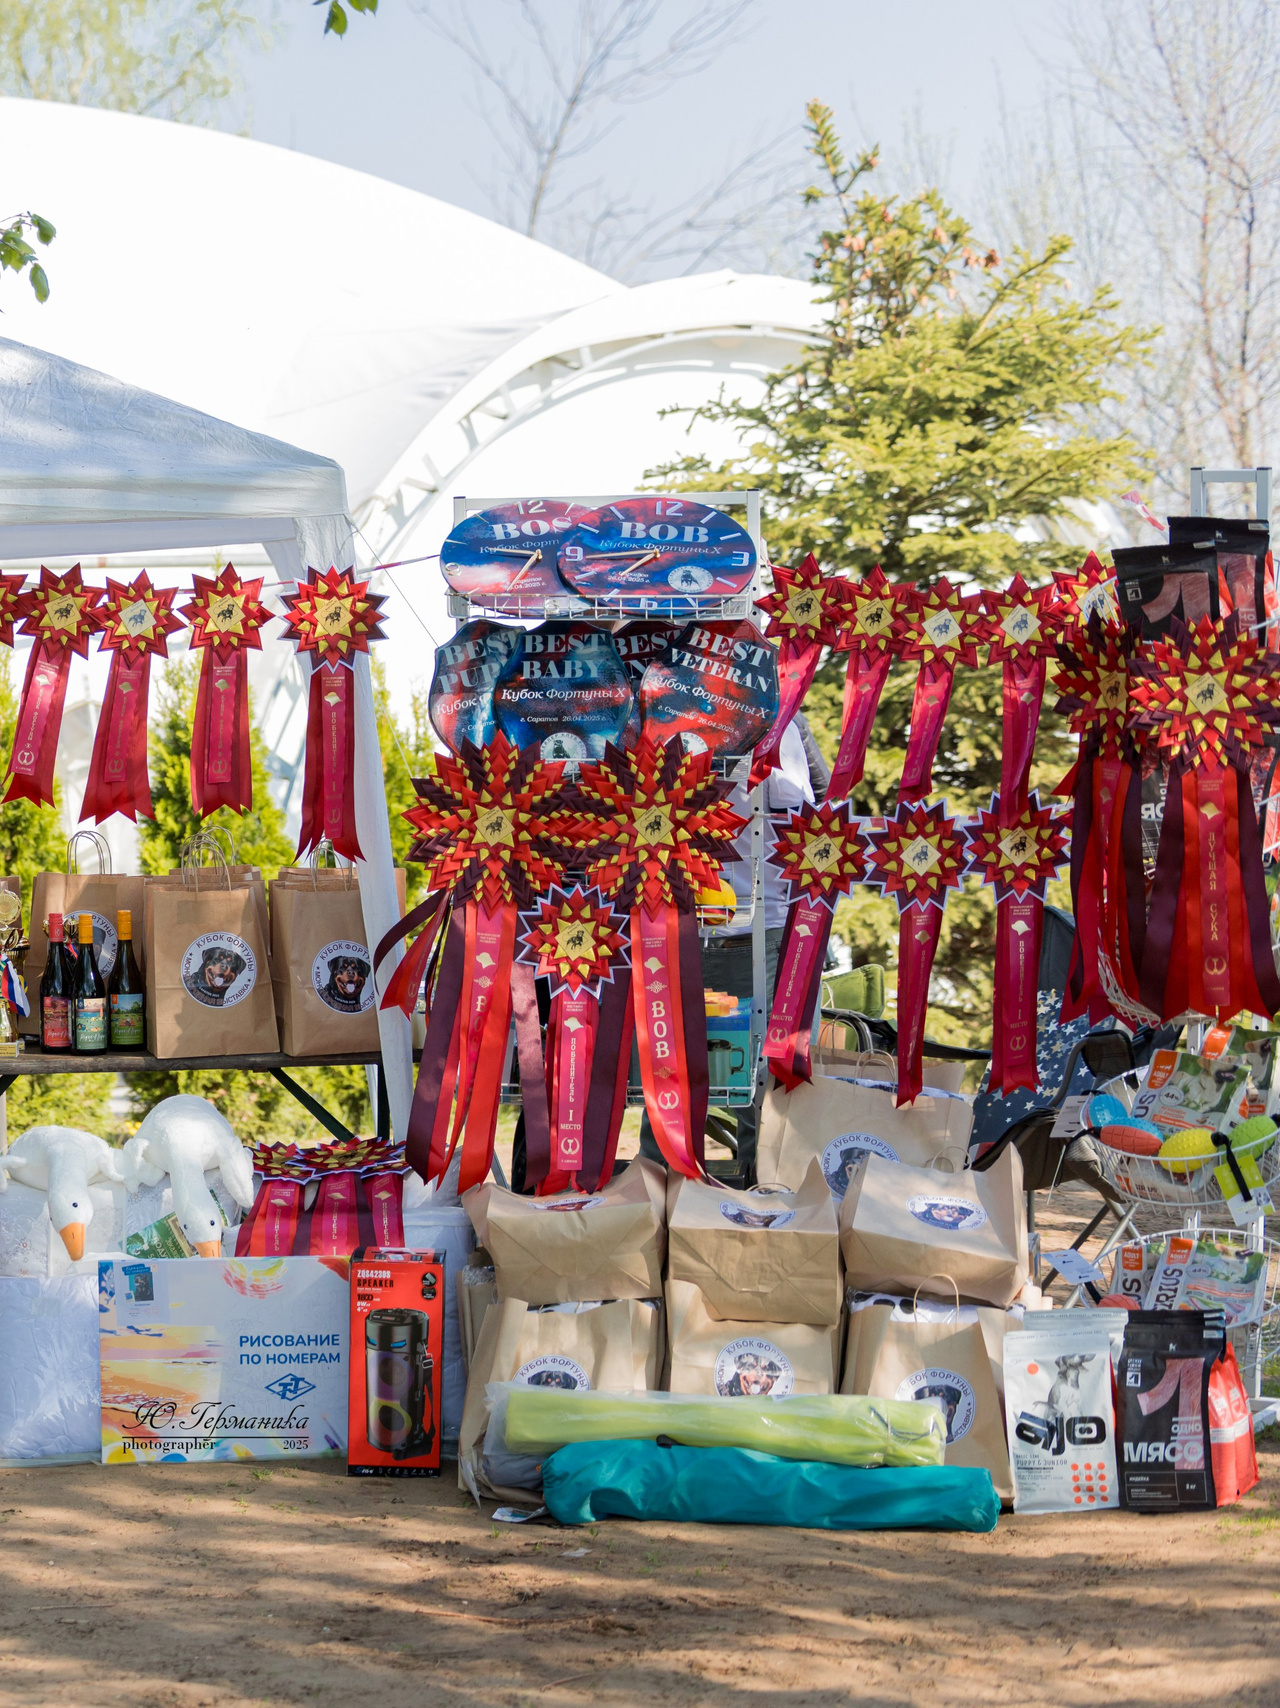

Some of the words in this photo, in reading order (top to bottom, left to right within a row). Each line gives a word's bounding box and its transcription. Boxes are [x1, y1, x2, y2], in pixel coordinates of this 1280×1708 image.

[516, 500, 546, 515] 12
[655, 500, 684, 516] 12
[620, 521, 709, 543] BOB
[565, 546, 584, 562] 9
[599, 539, 641, 552] Кубок
[643, 541, 709, 555] Фортуны
[731, 550, 750, 567] 3
[443, 630, 517, 667] BEST
[523, 633, 606, 654] BEST
[688, 626, 772, 668] BEST
[521, 659, 604, 679] BABY
[670, 647, 773, 693] VETERAN
[501, 688, 544, 702] Кубок
[546, 688, 613, 701] Фортуны
[691, 685, 756, 715] Фортуны
[436, 697, 477, 716] Кубок
[526, 715, 559, 723] Саратов
[664, 705, 695, 720] Саратов
[697, 716, 734, 734] 26.04.2025
[1209, 903, 1219, 941] СУКА
[195, 933, 225, 949] КУБОК
[226, 936, 255, 972] ФОРТУНЫ
[320, 942, 344, 961] КУБОК
[651, 1000, 670, 1059] BOB
[560, 1122, 581, 1130] МЕСТО
[832, 1134, 862, 1149] КУБОК
[1134, 1183, 1158, 1194] SIRUS
[357, 1279, 394, 1288] SPEAKER
[239, 1333, 340, 1348] РИСОВАНИЕ
[239, 1353, 262, 1366] ПО
[265, 1351, 341, 1365] НОМЕРАМ
[725, 1339, 755, 1356] КУБОК
[756, 1341, 791, 1377] ФОРТУНЫ
[519, 1357, 548, 1378] КУБОК
[550, 1358, 588, 1389] ФОРТУНЫ
[930, 1370, 971, 1398] ФОРТУНЫ
[1171, 1422, 1202, 1435] ОДНО
[1123, 1441, 1204, 1463] МЯСО
